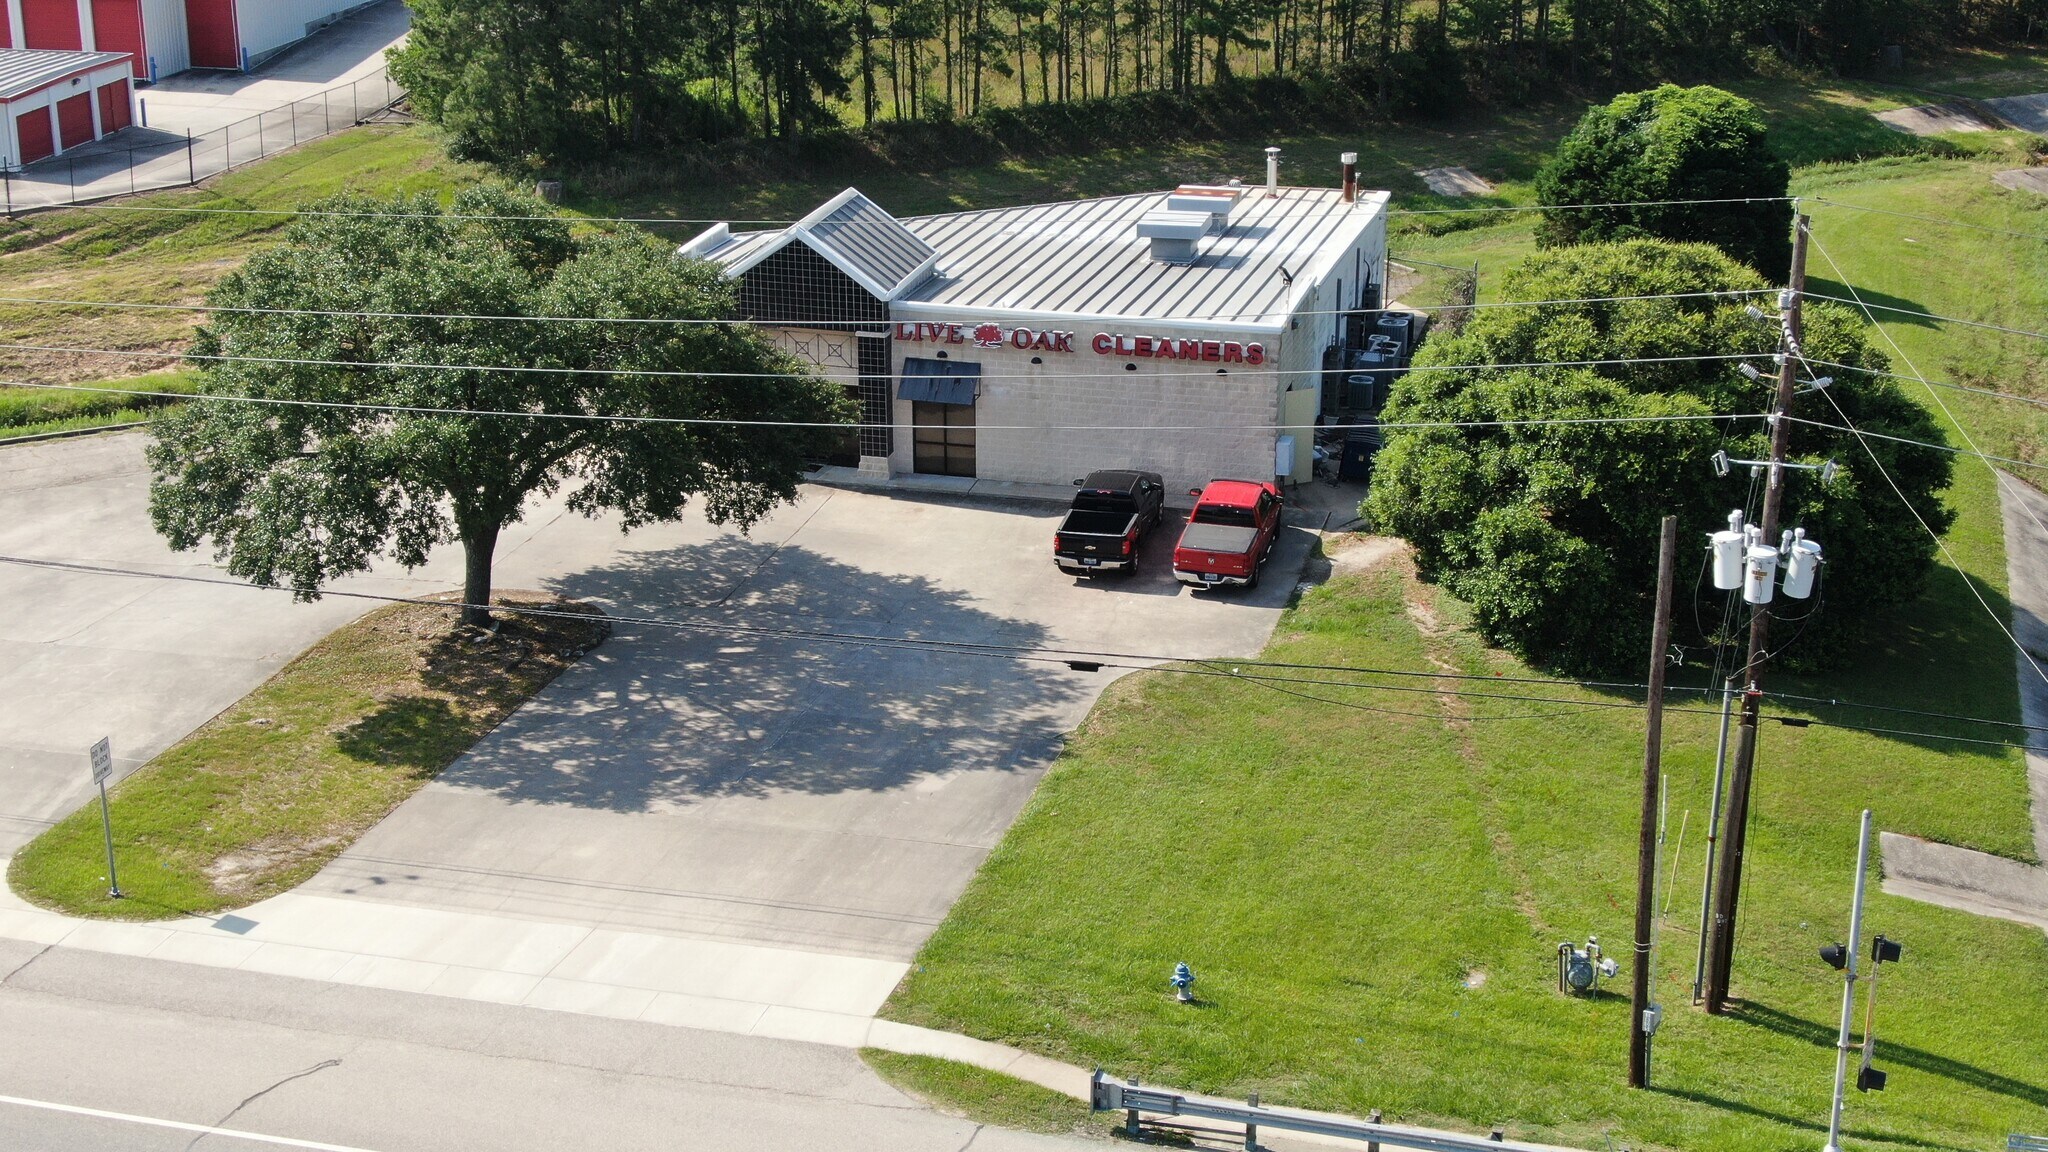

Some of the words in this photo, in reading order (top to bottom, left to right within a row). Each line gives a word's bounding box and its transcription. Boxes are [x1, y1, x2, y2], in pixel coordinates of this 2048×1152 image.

[895, 322, 964, 344] LIVE
[1011, 327, 1074, 353] OAK
[1092, 332, 1266, 365] CLEANERS
[94, 753, 108, 768] BLOCK
